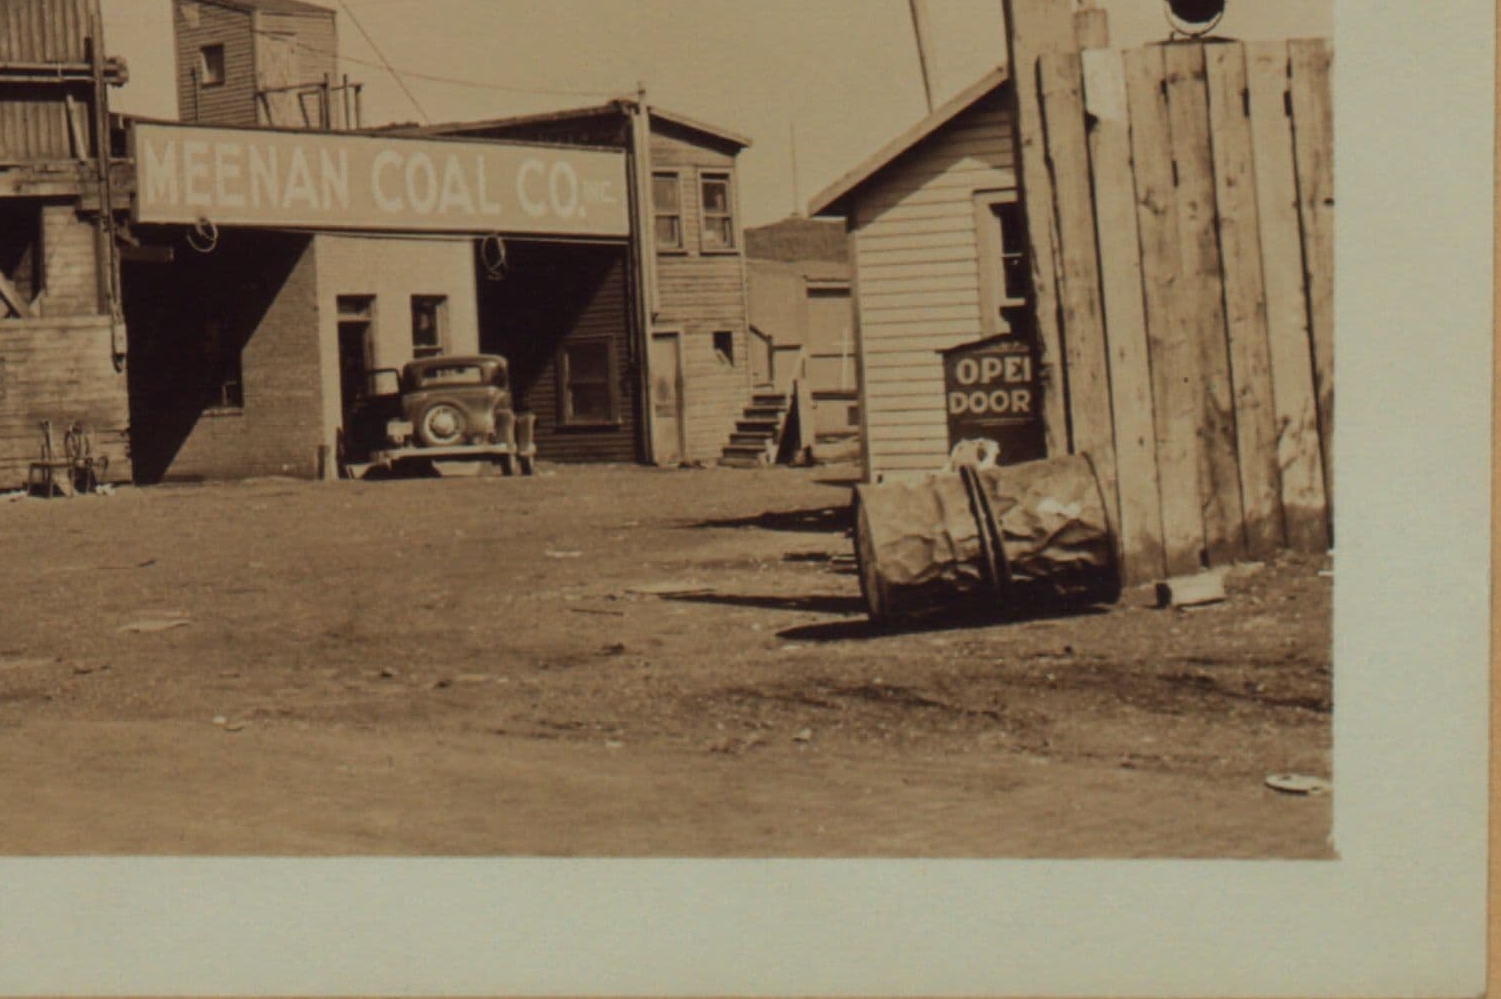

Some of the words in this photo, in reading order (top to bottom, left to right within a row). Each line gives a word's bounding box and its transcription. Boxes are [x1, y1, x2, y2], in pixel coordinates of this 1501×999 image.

[145, 138, 347, 210] MEENAN
[372, 151, 500, 216] COAL
[517, 159, 586, 218] CO.
[950, 390, 1031, 414] DOOR
